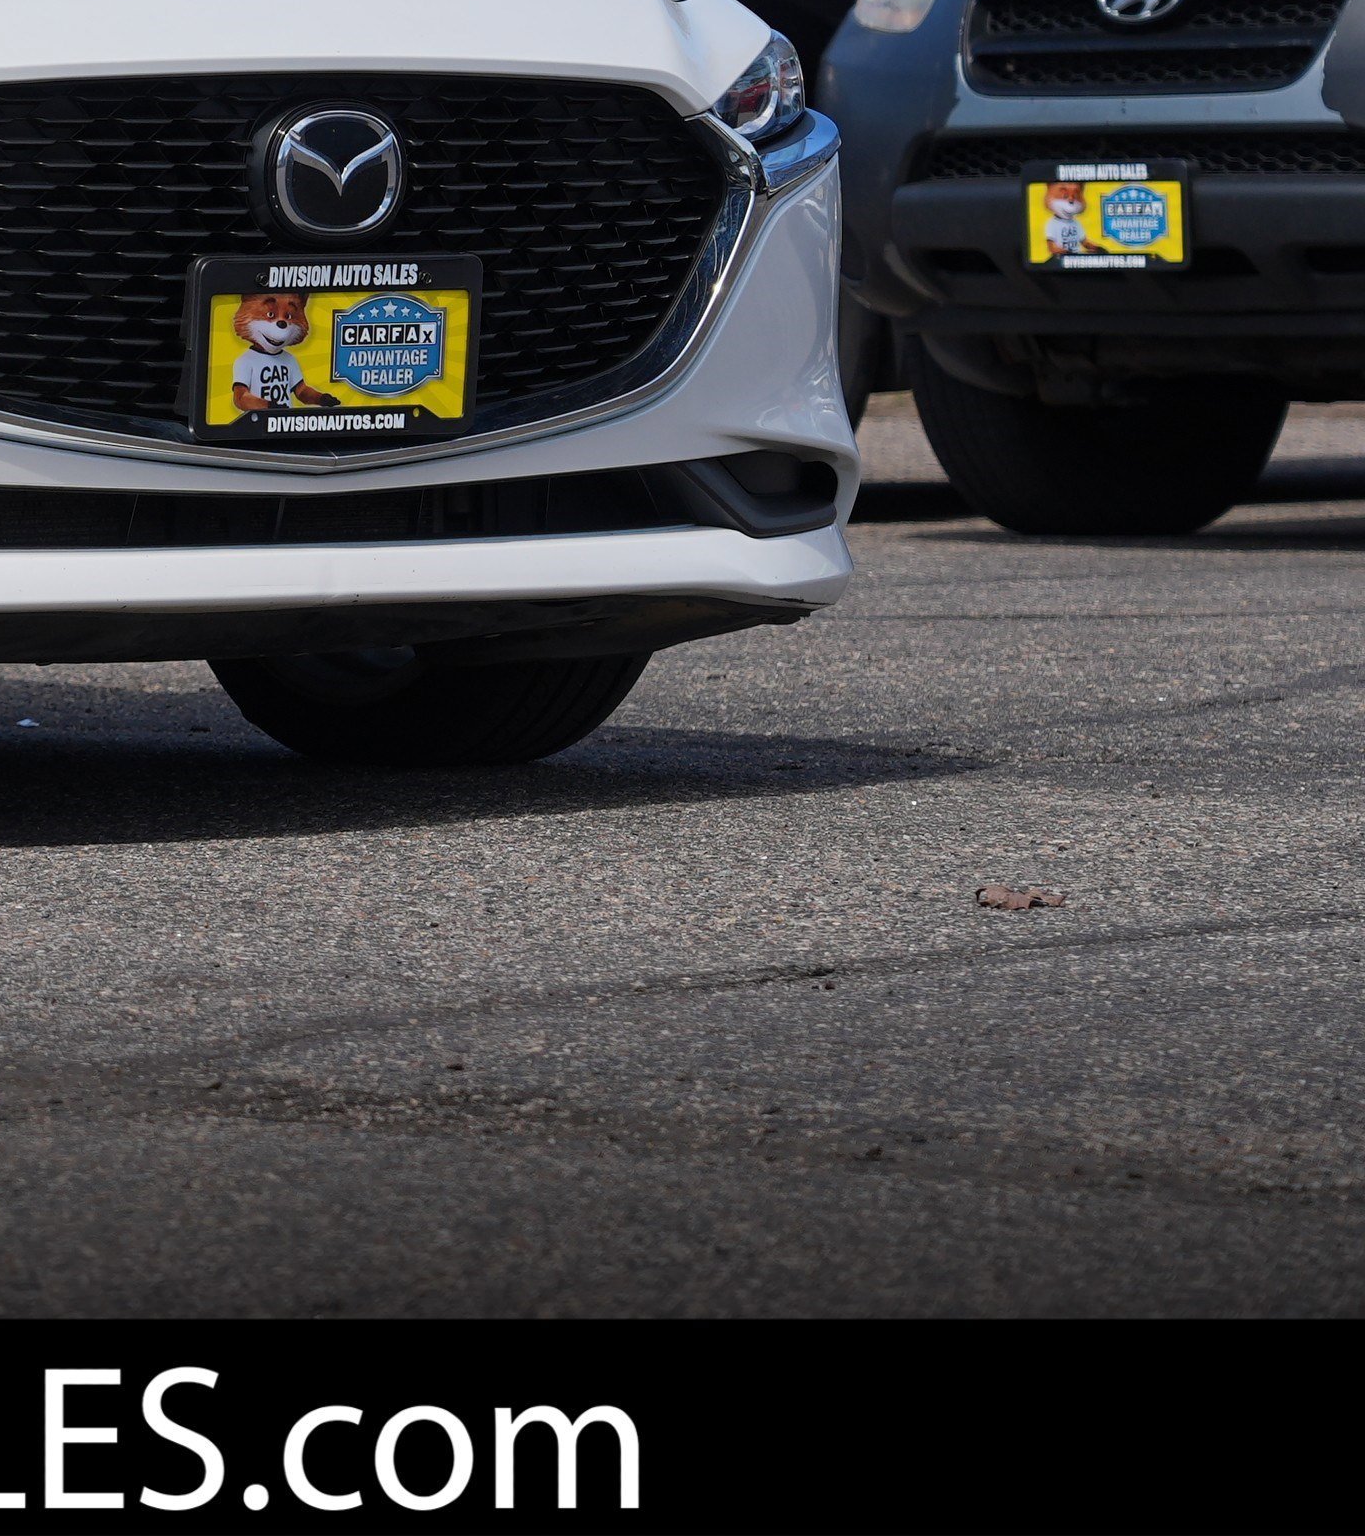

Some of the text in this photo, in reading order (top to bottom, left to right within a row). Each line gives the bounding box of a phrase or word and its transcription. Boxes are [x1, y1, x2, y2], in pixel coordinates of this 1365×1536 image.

[1059, 164, 1148, 180] DIVISION AUTO SALES
[1111, 218, 1159, 229] ADVANTAGE
[269, 264, 418, 288] DIVISION AUTO SALES
[342, 323, 436, 346] CARFAX
[348, 349, 428, 367] ADVANTAGE
[260, 365, 289, 383] CAR
[361, 368, 413, 386] DEALER
[260, 385, 289, 402] FOX
[267, 414, 405, 433] DIVISIONAUTOS.COM
